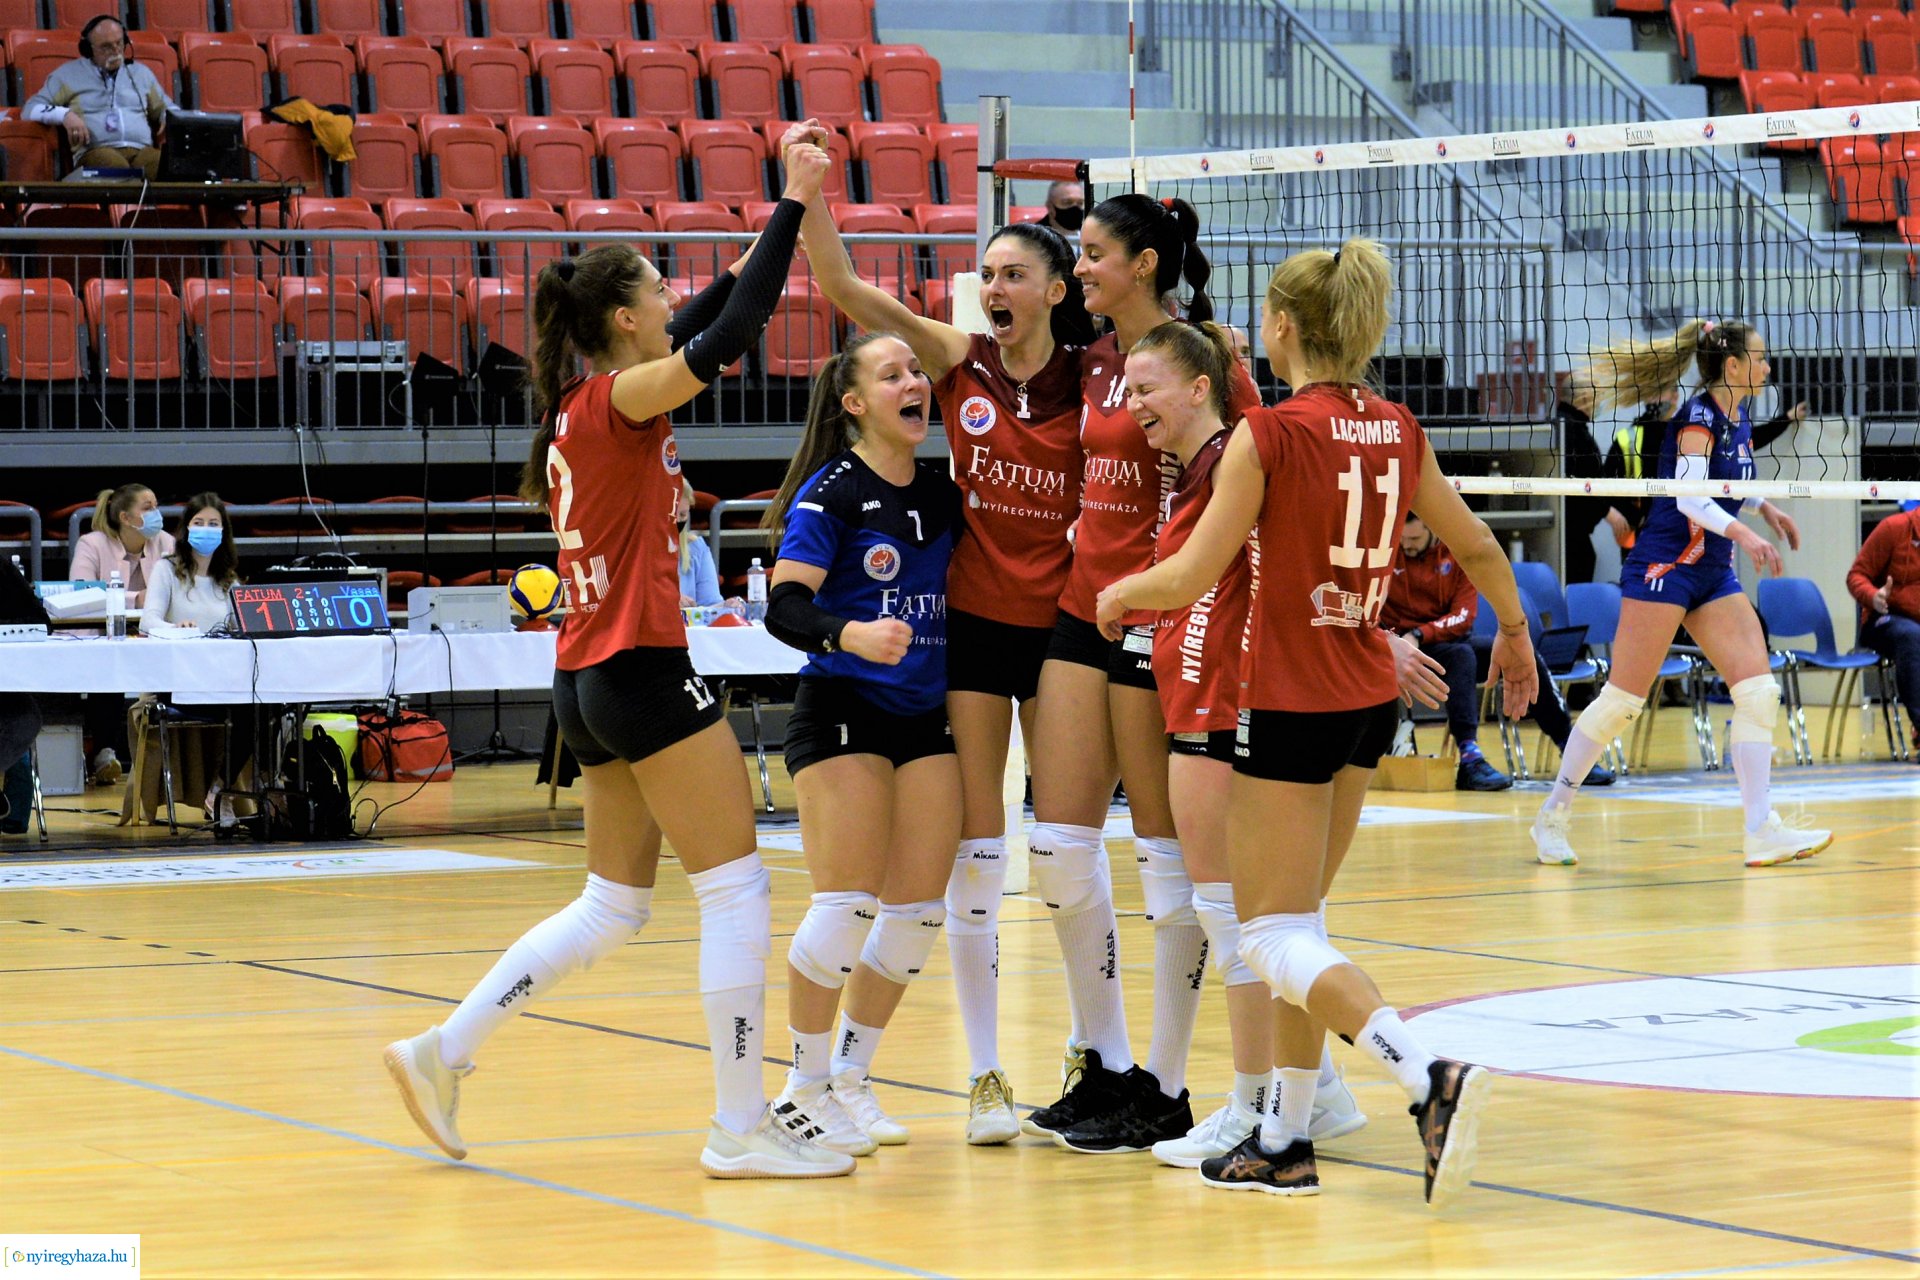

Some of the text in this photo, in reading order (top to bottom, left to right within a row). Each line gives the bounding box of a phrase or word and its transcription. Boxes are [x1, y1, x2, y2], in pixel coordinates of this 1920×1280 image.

[1625, 127, 1654, 140] FATUM
[1766, 117, 1795, 130] FATUM
[1367, 145, 1392, 158] FATUM
[1492, 137, 1519, 150] FATUM
[1102, 375, 1127, 408] 14
[1017, 394, 1031, 419] 1
[1330, 416, 1401, 445] LACOMBE
[968, 444, 1067, 490] FATUM
[1789, 483, 1811, 494] FATUM
[981, 500, 1064, 522] NYÍREGYHÁZA
[1082, 499, 1140, 514] YÍREGYHÁZA
[1329, 455, 1400, 569] 11
[234, 588, 282, 601] FATUM
[256, 597, 373, 631] 1 0
[973, 850, 1000, 860] MIKASA
[1101, 929, 1115, 979] MIKASA
[1188, 939, 1209, 990] MIKASA
[497, 974, 534, 1008] MIKASA
[734, 1017, 753, 1060] MIKASA
[842, 1029, 858, 1057] MIKASA
[795, 1042, 804, 1070] MIKASA
[1251, 1086, 1266, 1115] MIKASA
[1271, 1081, 1282, 1116] MIKASA
